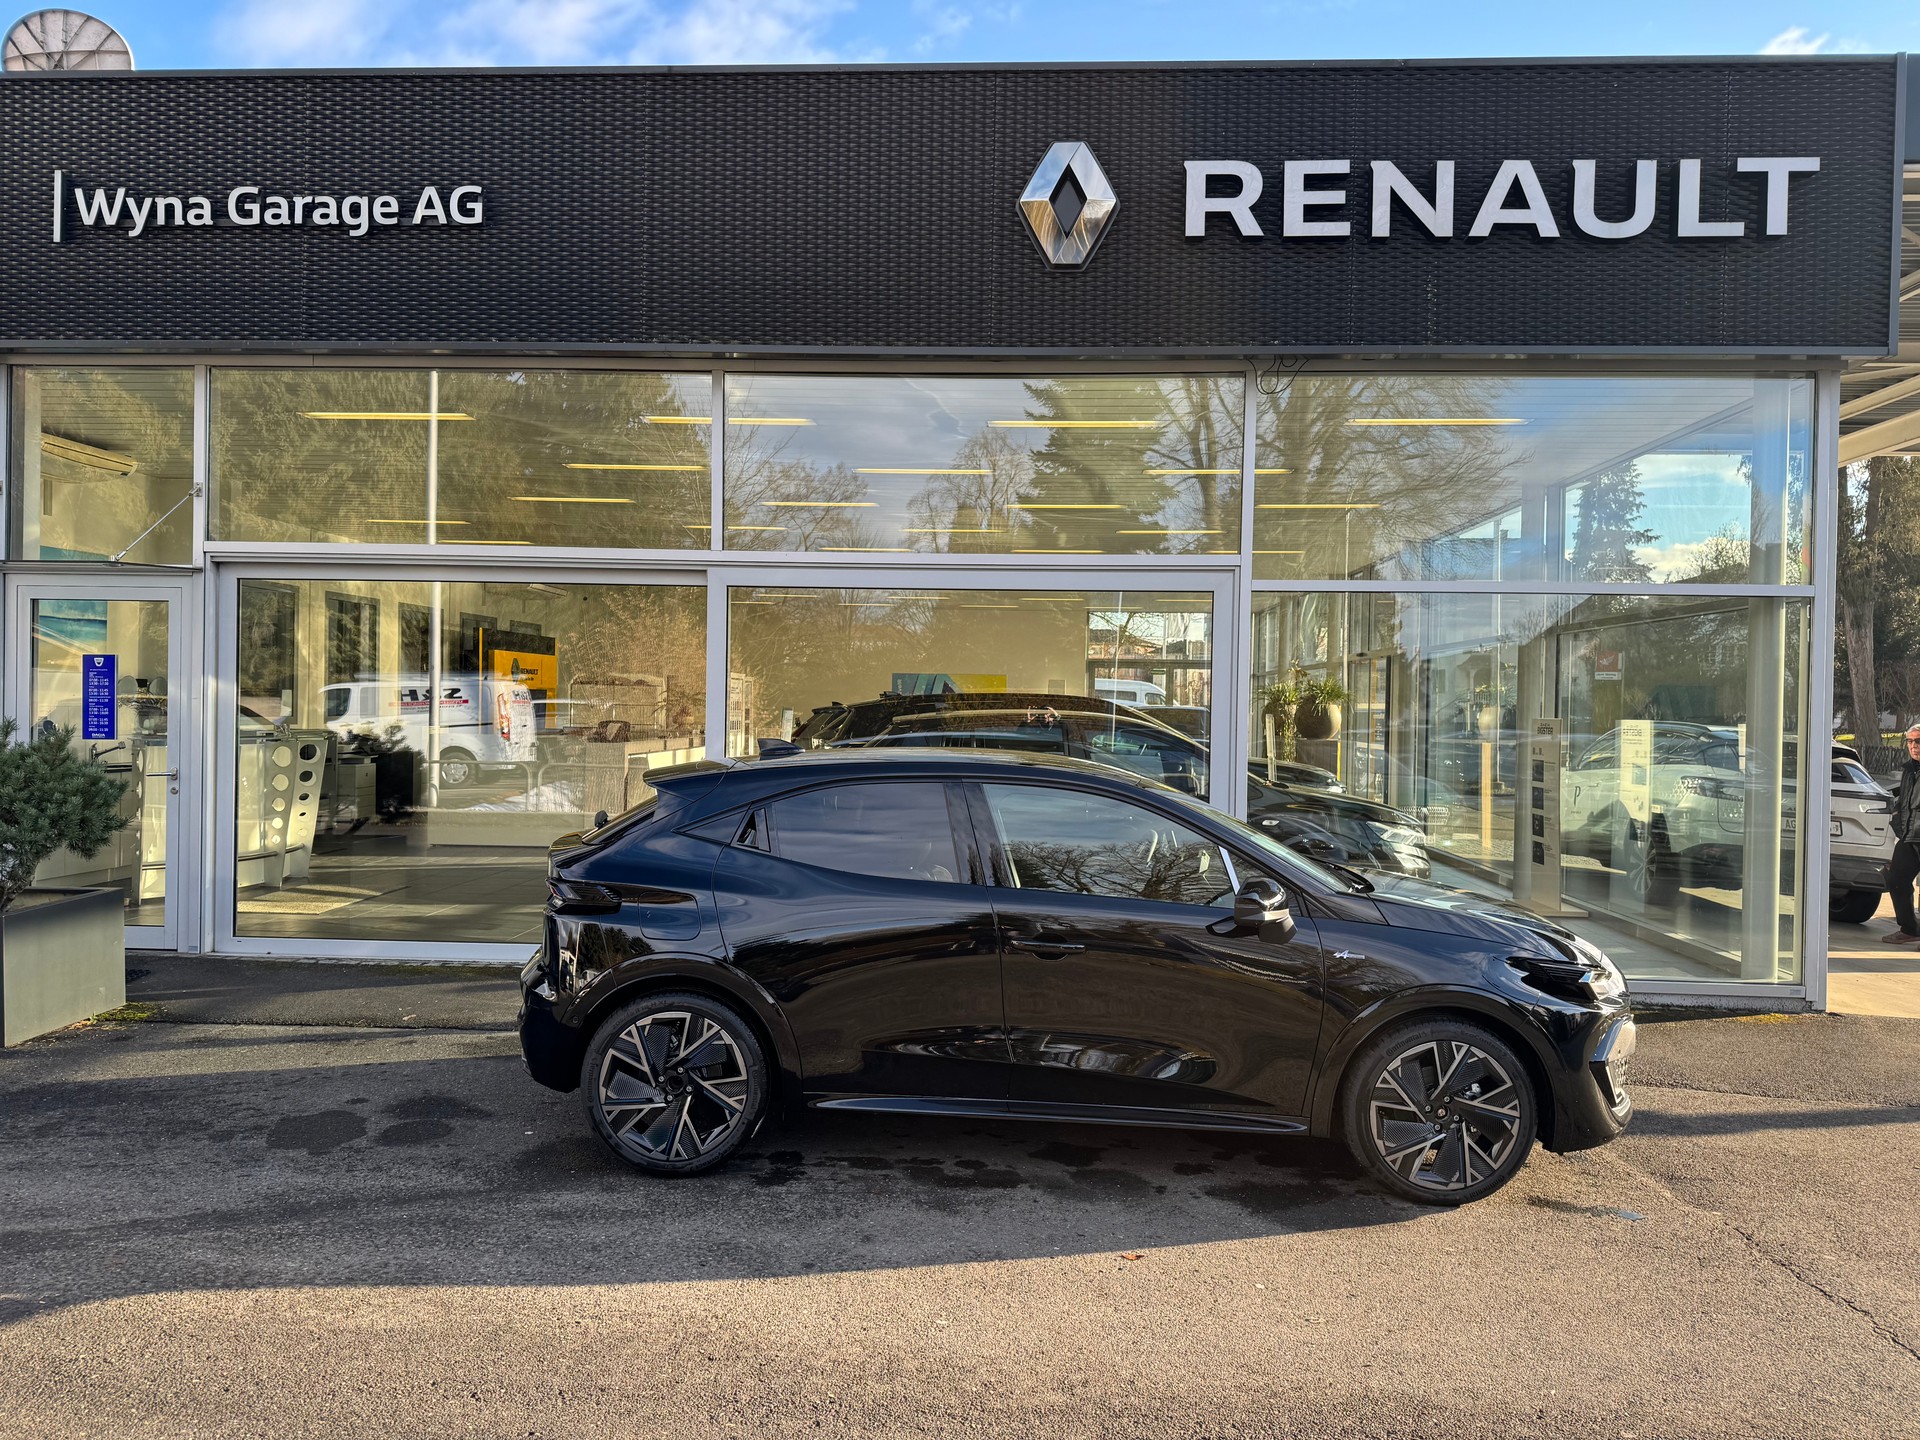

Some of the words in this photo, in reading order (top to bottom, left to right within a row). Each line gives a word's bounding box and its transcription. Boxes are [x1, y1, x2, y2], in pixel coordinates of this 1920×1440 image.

[75, 186, 214, 237] Wyna
[228, 186, 399, 237] Garage
[412, 186, 483, 226] AG
[1184, 157, 1820, 238] RENAULT
[1386, 1032, 1422, 1057] Continental
